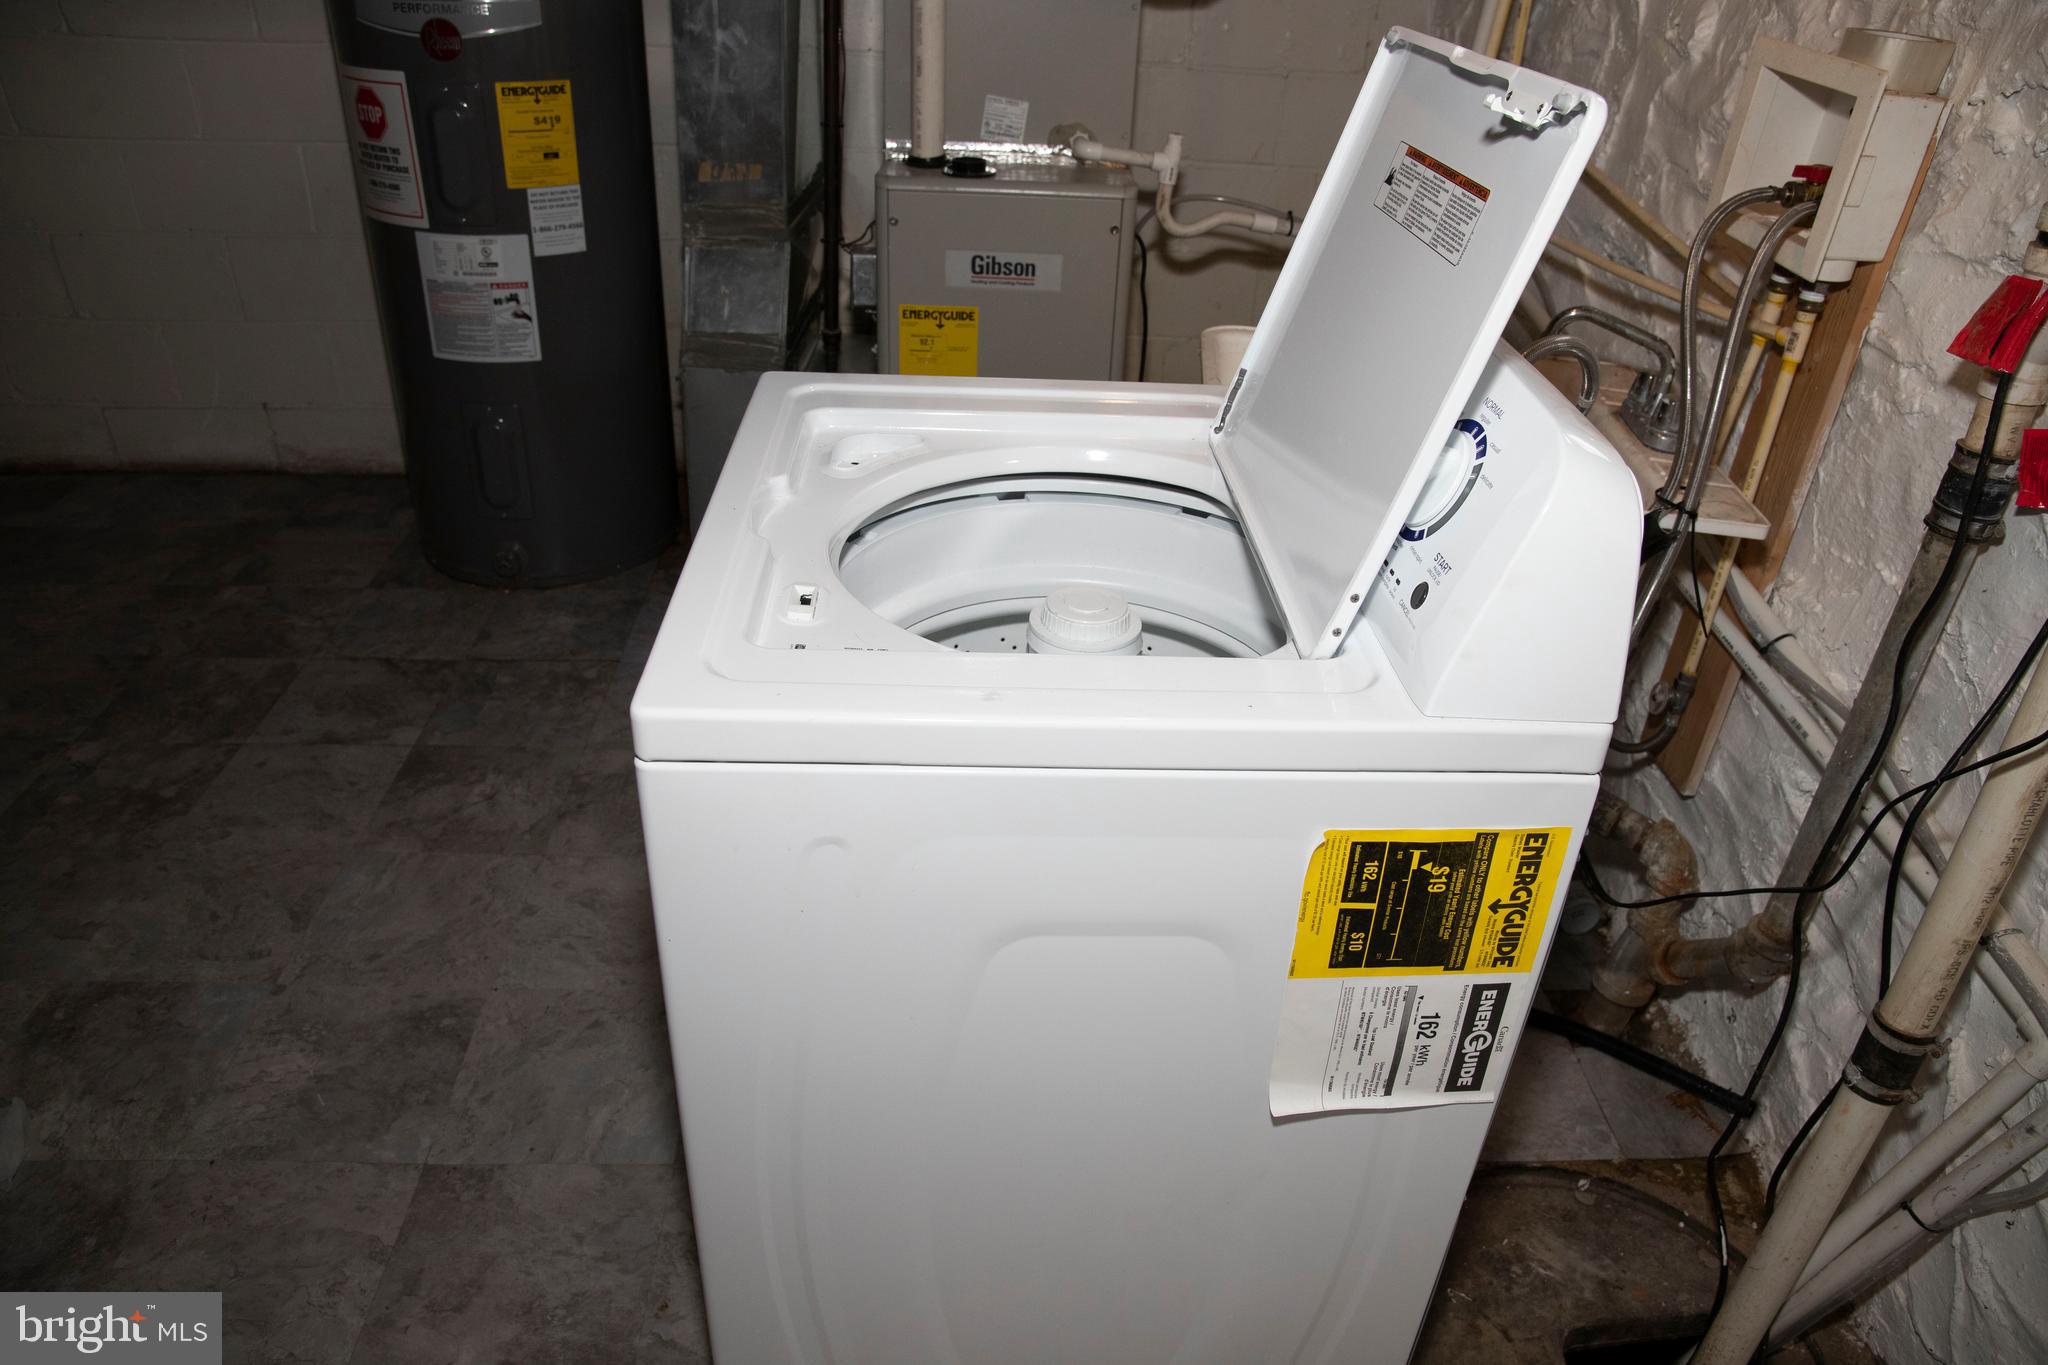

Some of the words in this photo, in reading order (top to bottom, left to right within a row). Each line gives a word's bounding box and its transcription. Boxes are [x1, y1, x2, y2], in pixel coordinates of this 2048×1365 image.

[501, 85, 568, 98] ENERGYGUIDE
[358, 102, 384, 124] STOP
[971, 254, 1036, 278] Gibson
[902, 310, 976, 322] ENERGYGUIDE
[1482, 396, 1505, 420] NORMAL
[1433, 552, 1452, 576] START
[1483, 834, 1494, 859] Compare
[1363, 860, 1379, 880] 162
[1428, 866, 1451, 893] $19
[1479, 861, 1488, 876] ONLY
[1454, 869, 1465, 893] Estimated
[1473, 884, 1482, 899] other
[1450, 895, 1459, 911] Yearly
[1470, 900, 1478, 915] labels
[1492, 833, 1550, 968] ENERGYGUIDE
[1446, 912, 1455, 928] Energy
[1466, 917, 1474, 927] with
[1348, 932, 1365, 951] $10
[1461, 929, 1471, 945] yellow
[1387, 986, 1396, 1010] Consomme
[1461, 984, 1469, 1001] Energy
[1416, 1012, 1441, 1040] 162
[1453, 1002, 1465, 1033] consumption
[1457, 990, 1498, 1086] ENERGUIDE
[1416, 1045, 1431, 1067] kWh
[1444, 1035, 1457, 1068] Consommation
[1370, 1062, 1379, 1084] Consomme
